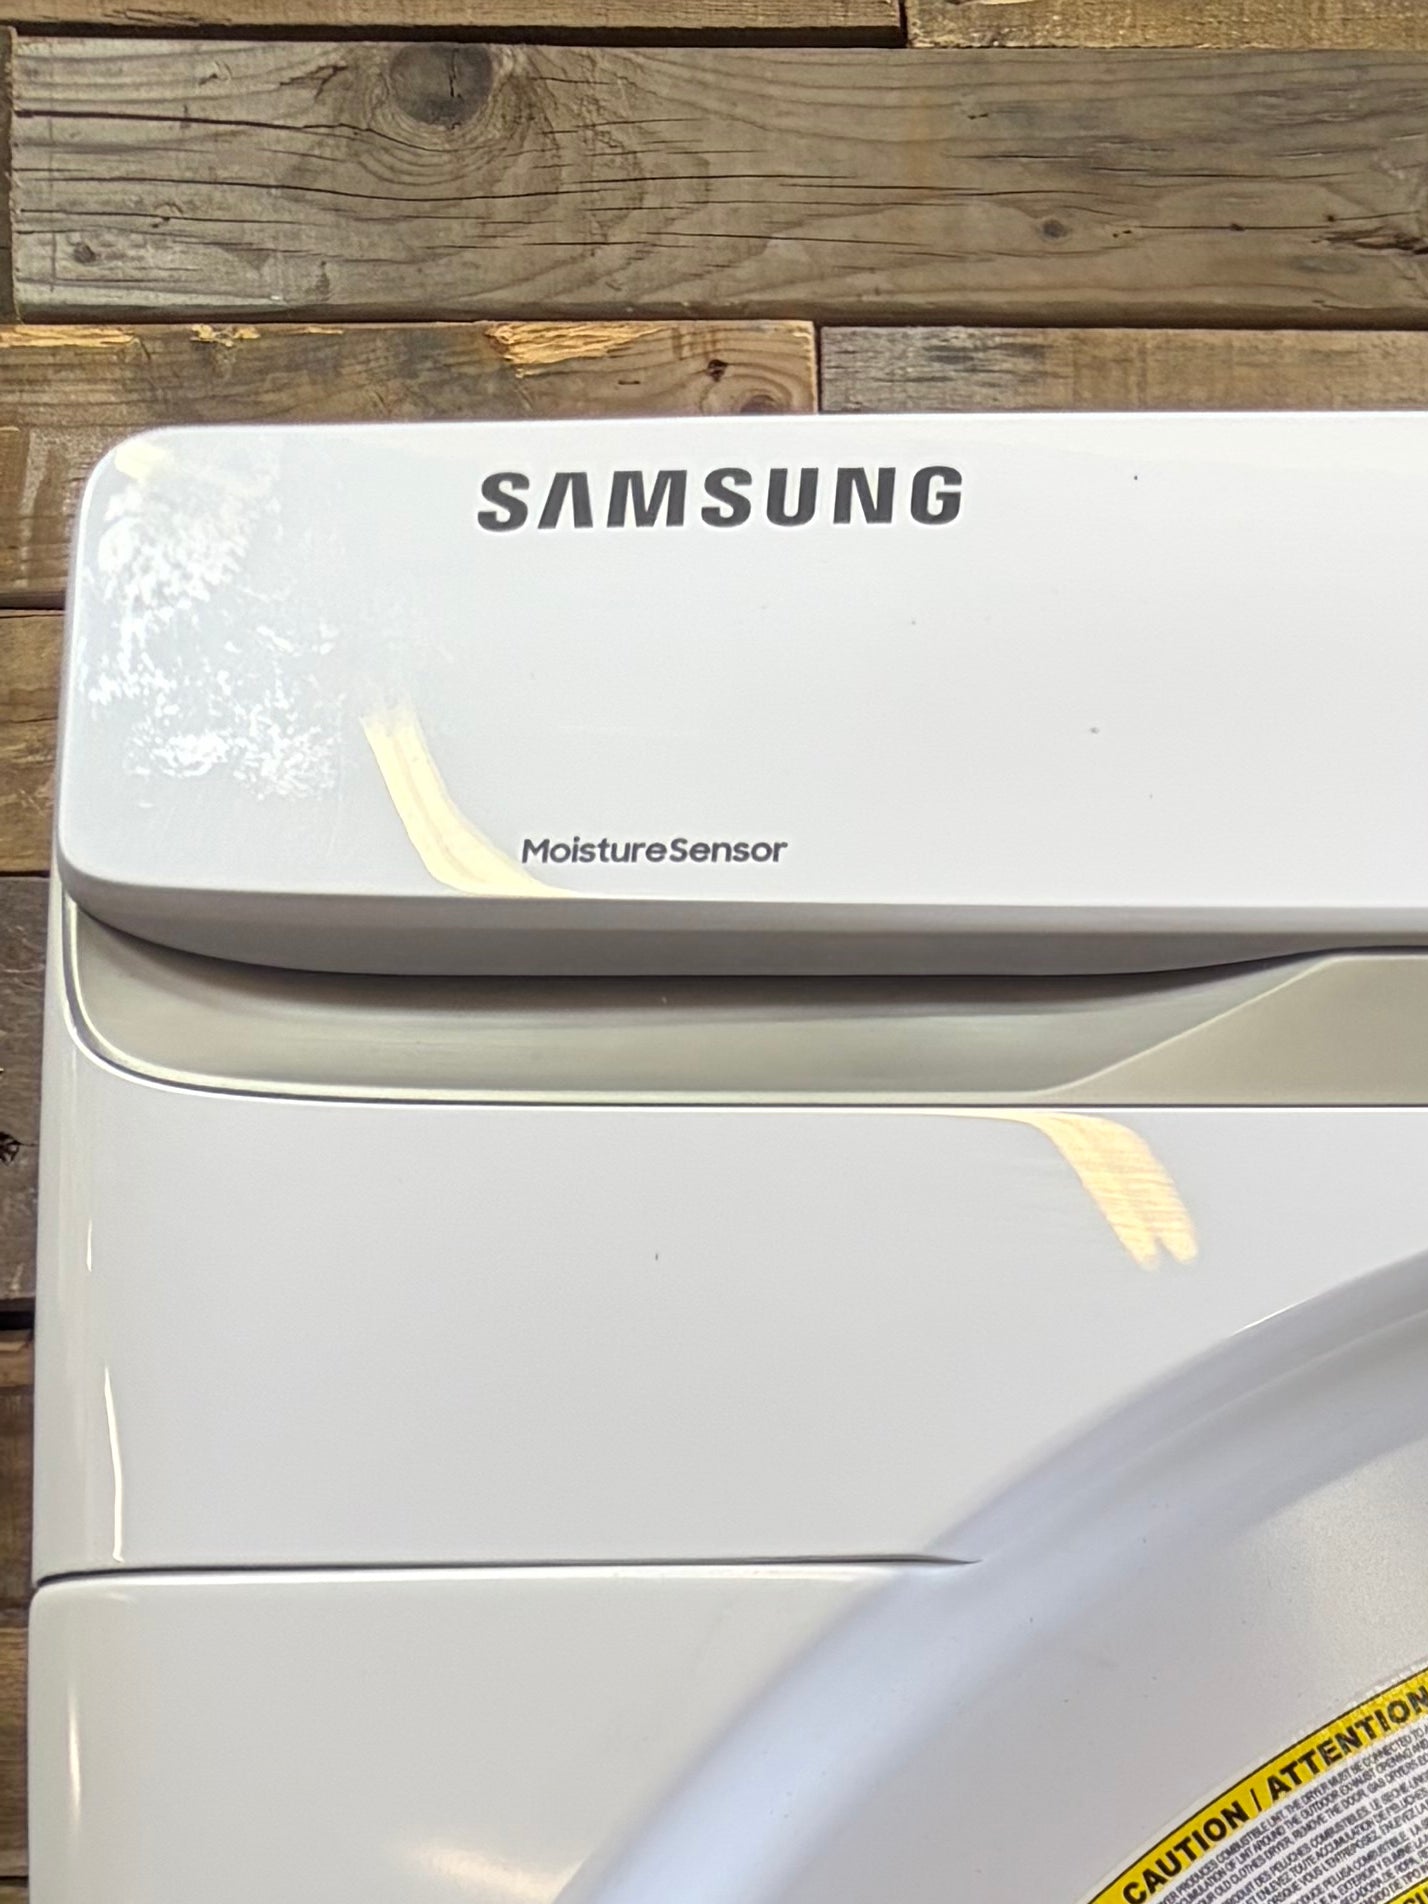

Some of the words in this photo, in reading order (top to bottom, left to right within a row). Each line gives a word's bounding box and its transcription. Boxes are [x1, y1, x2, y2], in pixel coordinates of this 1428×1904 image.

[478, 466, 962, 532] SAMSUNG
[522, 836, 788, 863] MoistureSensor
[1250, 1788, 1263, 1813] /
